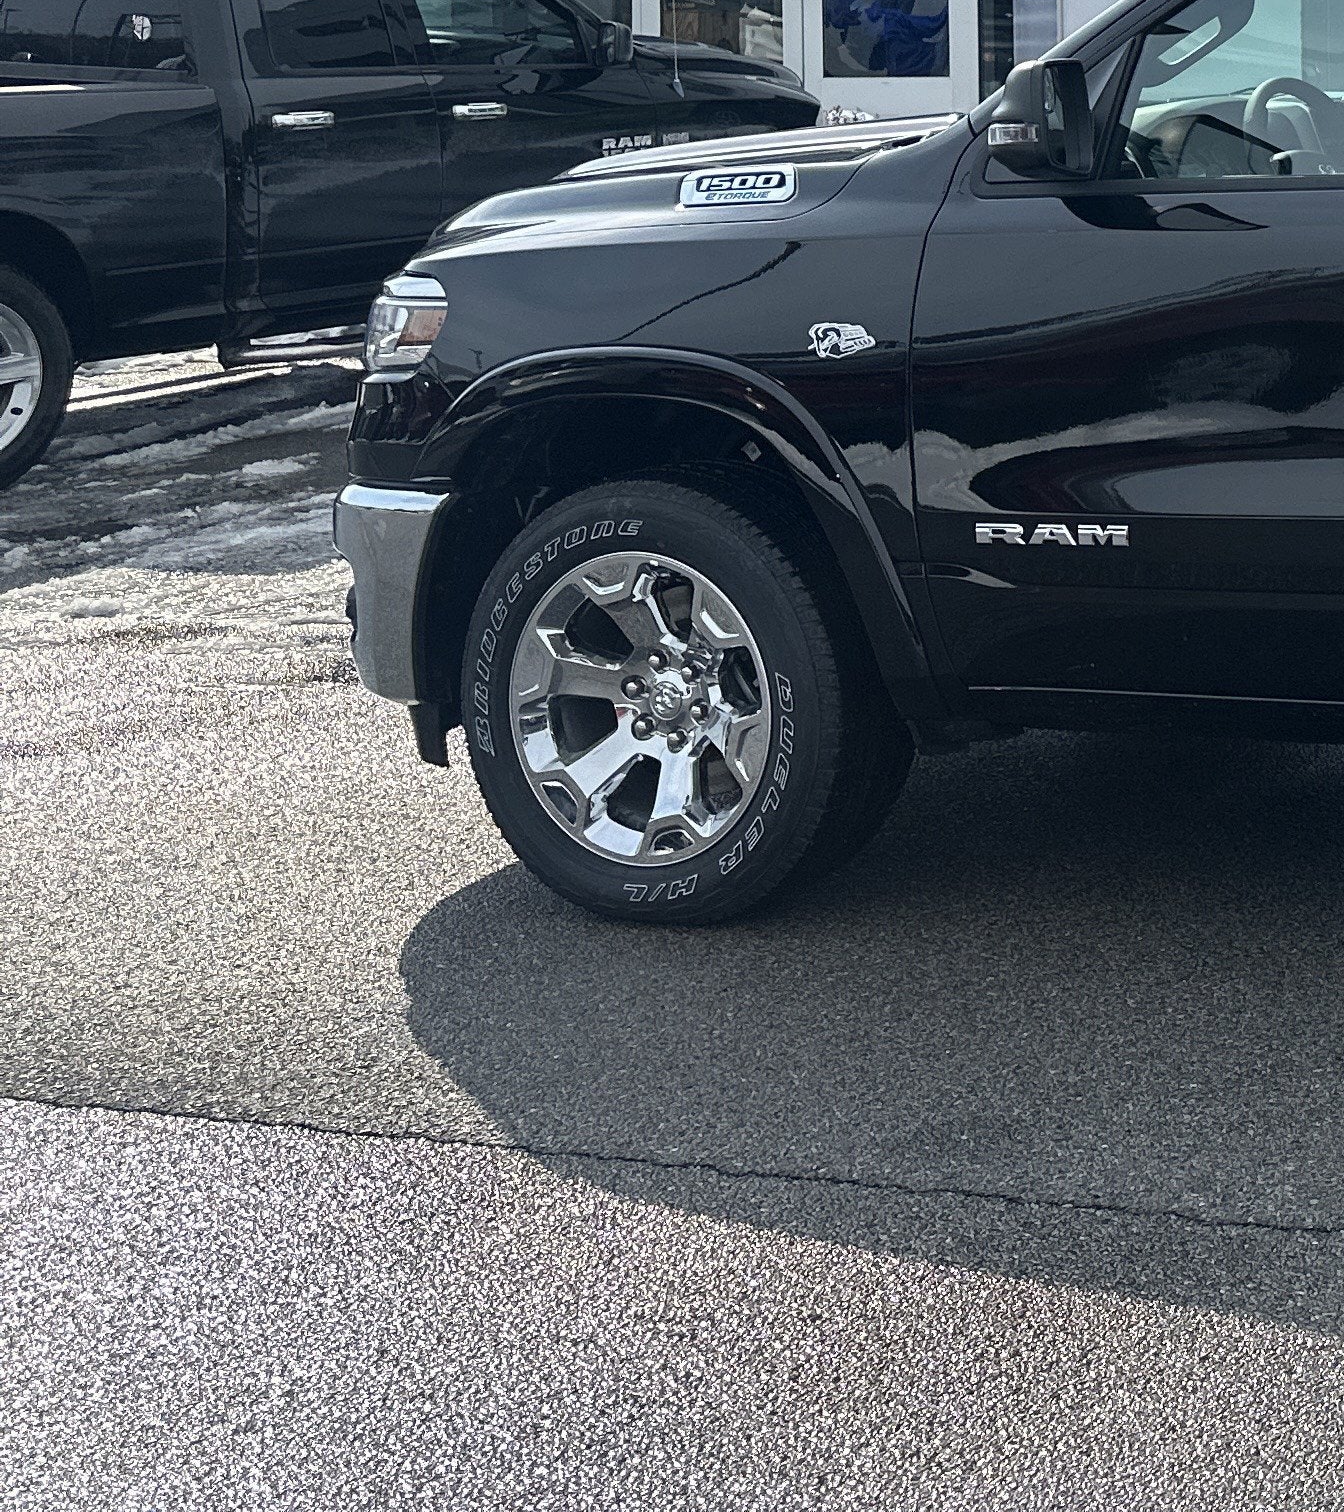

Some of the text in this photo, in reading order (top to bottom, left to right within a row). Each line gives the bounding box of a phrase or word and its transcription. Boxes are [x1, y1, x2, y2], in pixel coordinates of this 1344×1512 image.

[602, 134, 652, 150] RAM
[699, 174, 781, 191] 1500
[975, 522, 1130, 547] RAM
[466, 519, 643, 758] BRIDGESTONE
[623, 671, 796, 902] DUELER H/L
